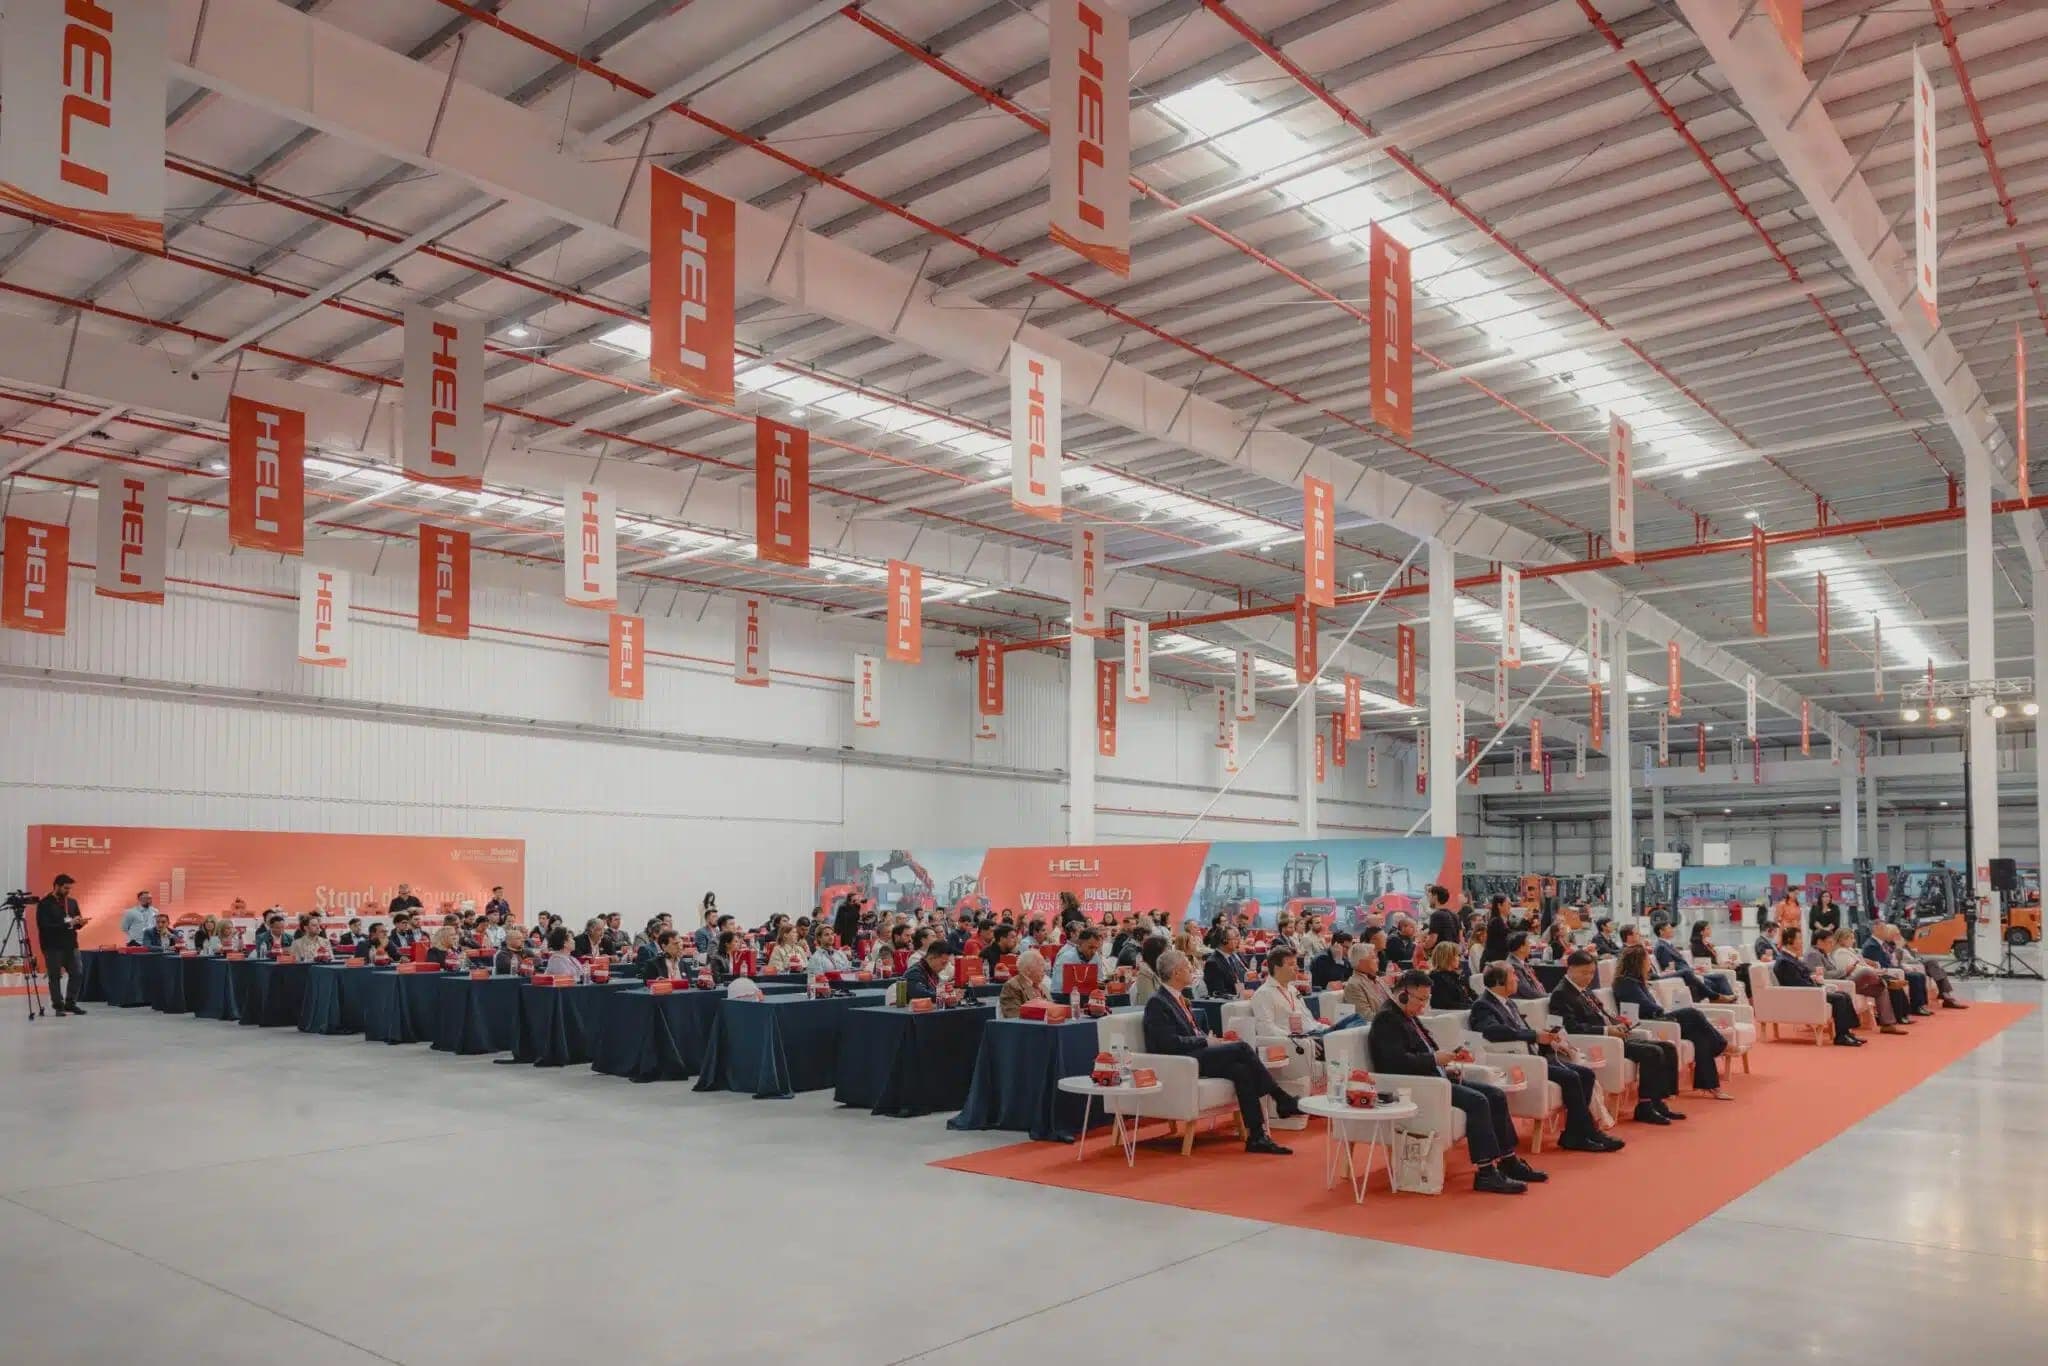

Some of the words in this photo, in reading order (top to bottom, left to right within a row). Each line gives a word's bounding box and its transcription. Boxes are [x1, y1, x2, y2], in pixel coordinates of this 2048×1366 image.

[1078, 0, 1104, 230] HELI
[681, 192, 707, 370] HELI
[1384, 243, 1398, 409] HELI
[431, 321, 458, 467] HELI
[1029, 359, 1045, 496] HELI
[256, 411, 280, 533] HELI
[775, 430, 792, 547] HELI
[24, 527, 48, 619] HELI
[120, 478, 145, 585] HELI
[582, 491, 600, 593] HELI
[1084, 529, 1094, 622] HELI
[315, 571, 333, 654] HELI
[435, 533, 454, 624] HELI
[898, 567, 911, 651] HELI
[621, 621, 633, 689] HELI
[747, 599, 758, 675] HELI
[863, 660, 872, 718] HELI
[50, 837, 111, 849] HELI
[1048, 859, 1100, 871] HELI
